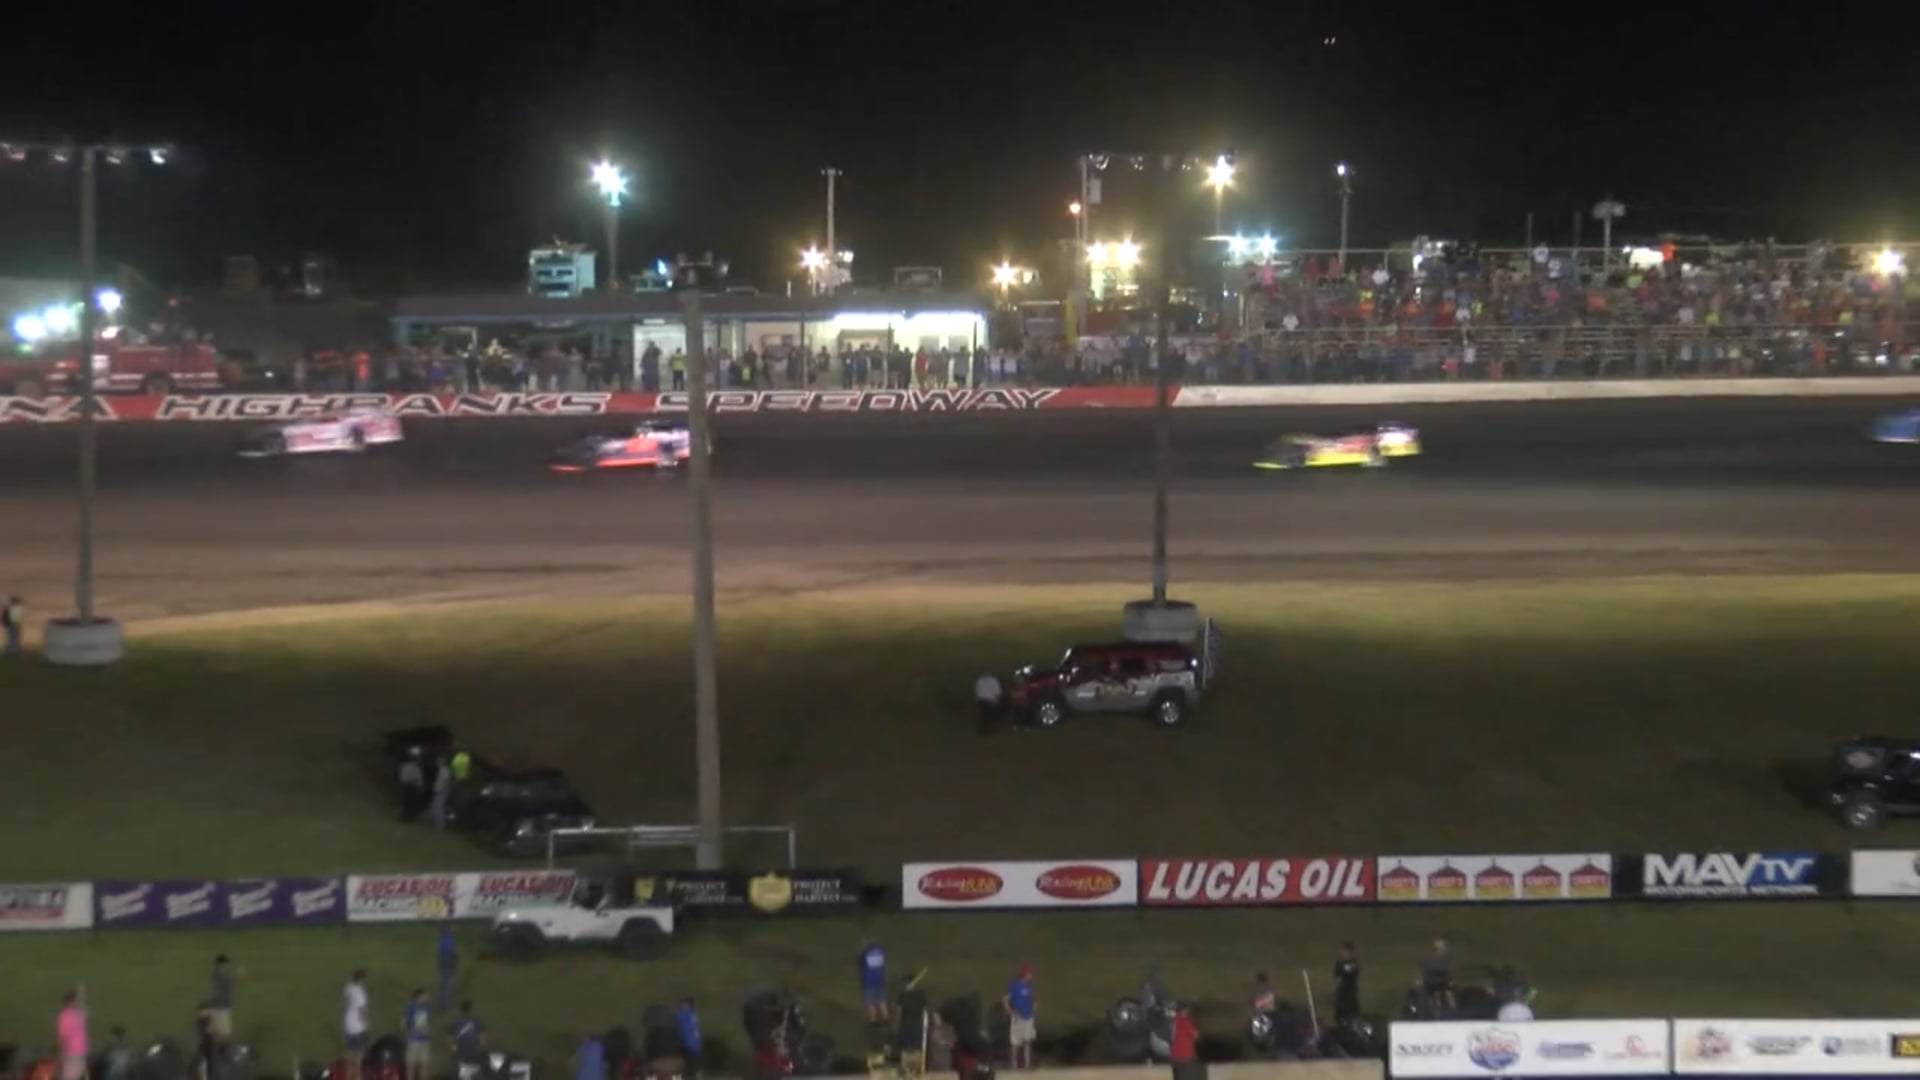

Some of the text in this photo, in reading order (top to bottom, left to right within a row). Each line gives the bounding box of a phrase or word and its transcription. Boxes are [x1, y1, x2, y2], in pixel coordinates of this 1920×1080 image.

[655, 388, 1061, 413] SPEEDWAY
[1147, 858, 1366, 900] LUCAS OIL
